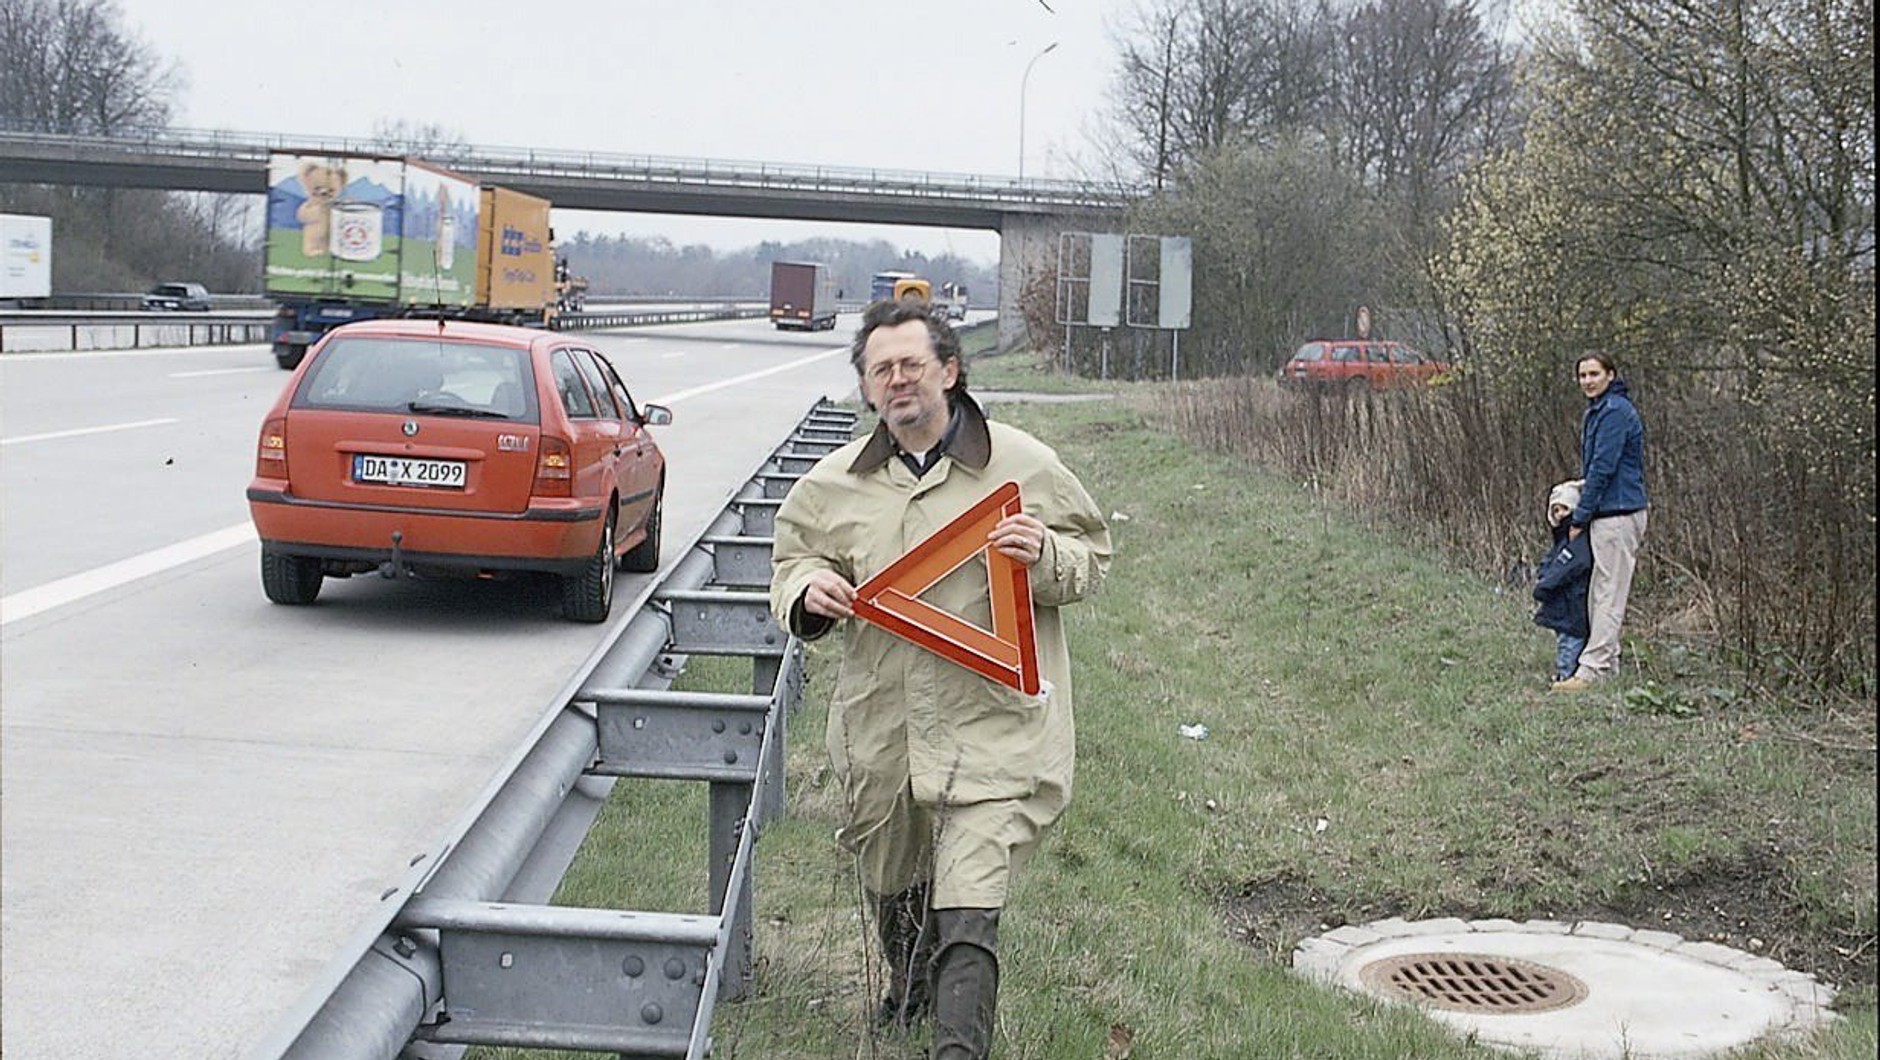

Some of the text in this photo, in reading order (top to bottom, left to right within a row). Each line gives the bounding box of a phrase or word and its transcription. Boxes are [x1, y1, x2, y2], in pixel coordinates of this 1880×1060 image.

[365, 459, 463, 482] DA X 2099
